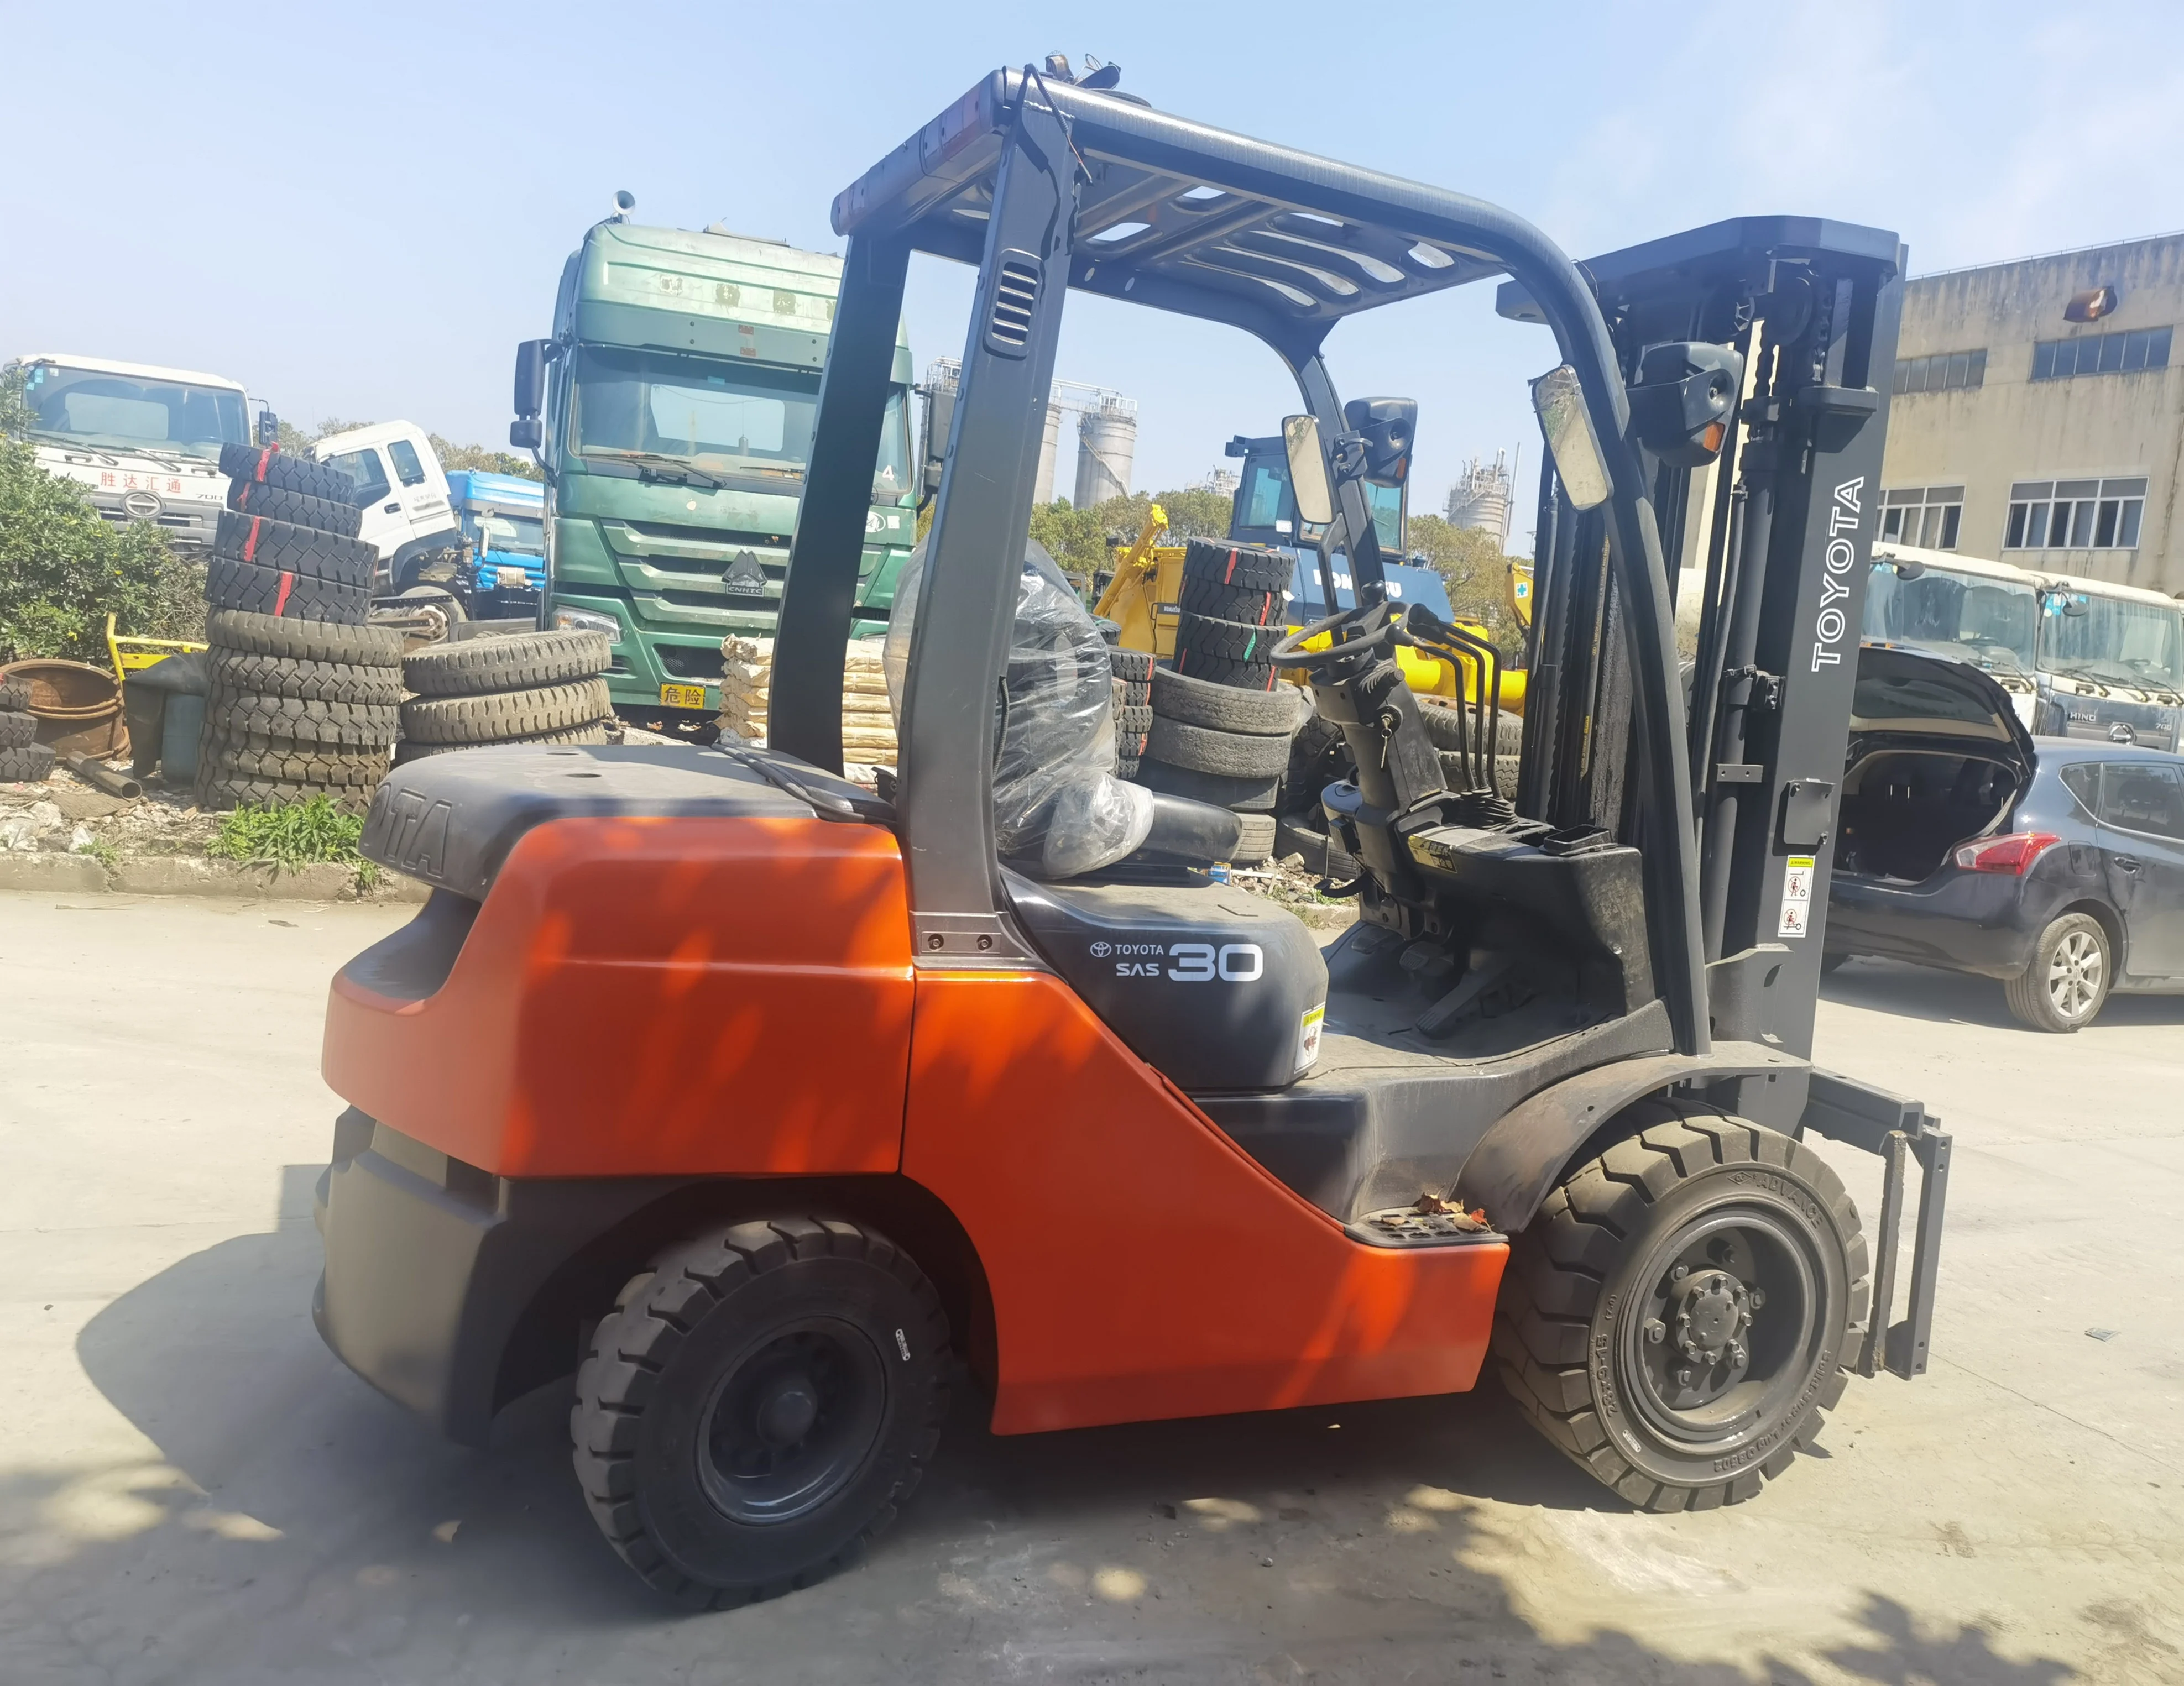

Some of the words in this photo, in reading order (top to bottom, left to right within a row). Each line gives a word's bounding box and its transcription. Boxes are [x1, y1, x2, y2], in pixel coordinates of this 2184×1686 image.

[882, 465, 894, 481] 4
[101, 472, 181, 494] 胜达汇通
[1811, 476, 1864, 672] TOYOTA
[664, 687, 701, 705] 危险
[2070, 711, 2096, 722] HINO
[1115, 944, 1164, 955] TOYOTA
[1116, 963, 1160, 976] SAS
[1168, 943, 1263, 982] 30
[1756, 1173, 1824, 1229] ADVANCE
